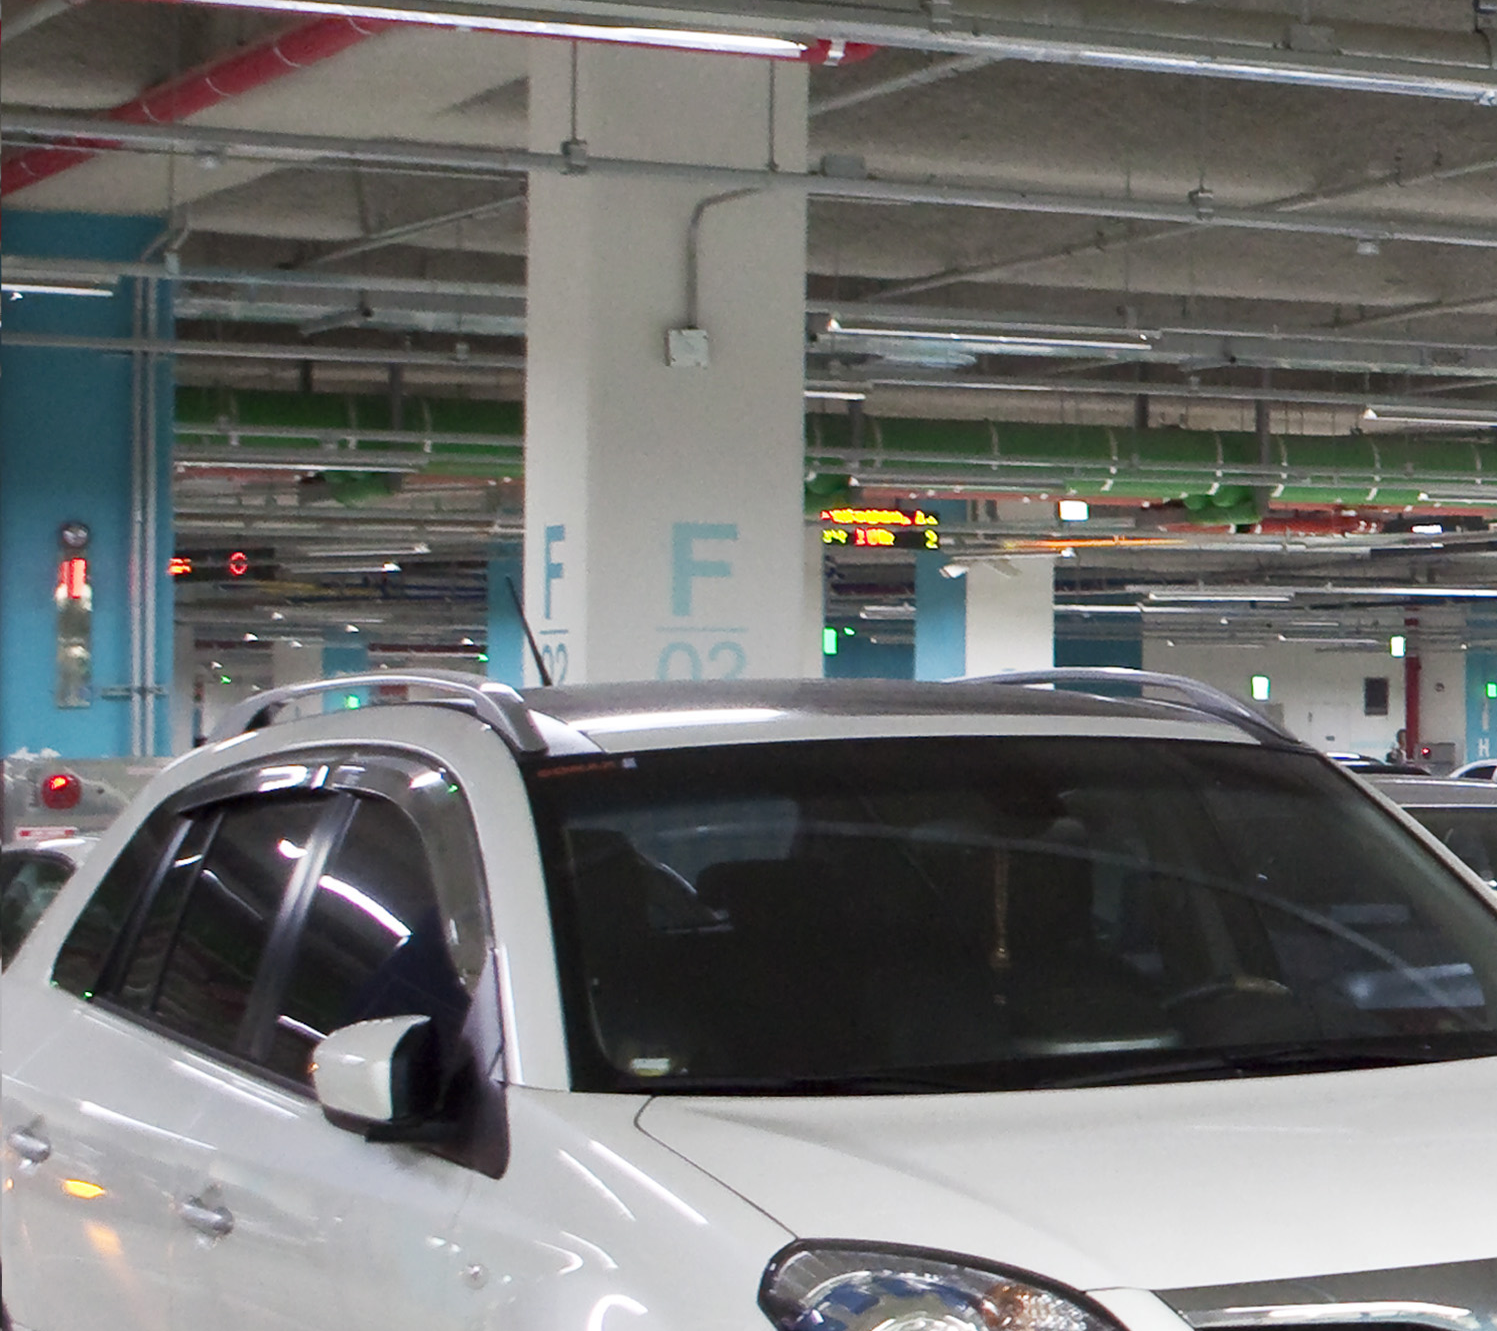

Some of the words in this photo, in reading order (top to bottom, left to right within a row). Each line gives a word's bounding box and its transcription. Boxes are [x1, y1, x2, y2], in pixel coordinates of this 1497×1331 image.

[545, 524, 565, 620] F
[671, 522, 739, 617] F
[657, 640, 748, 682] 02
